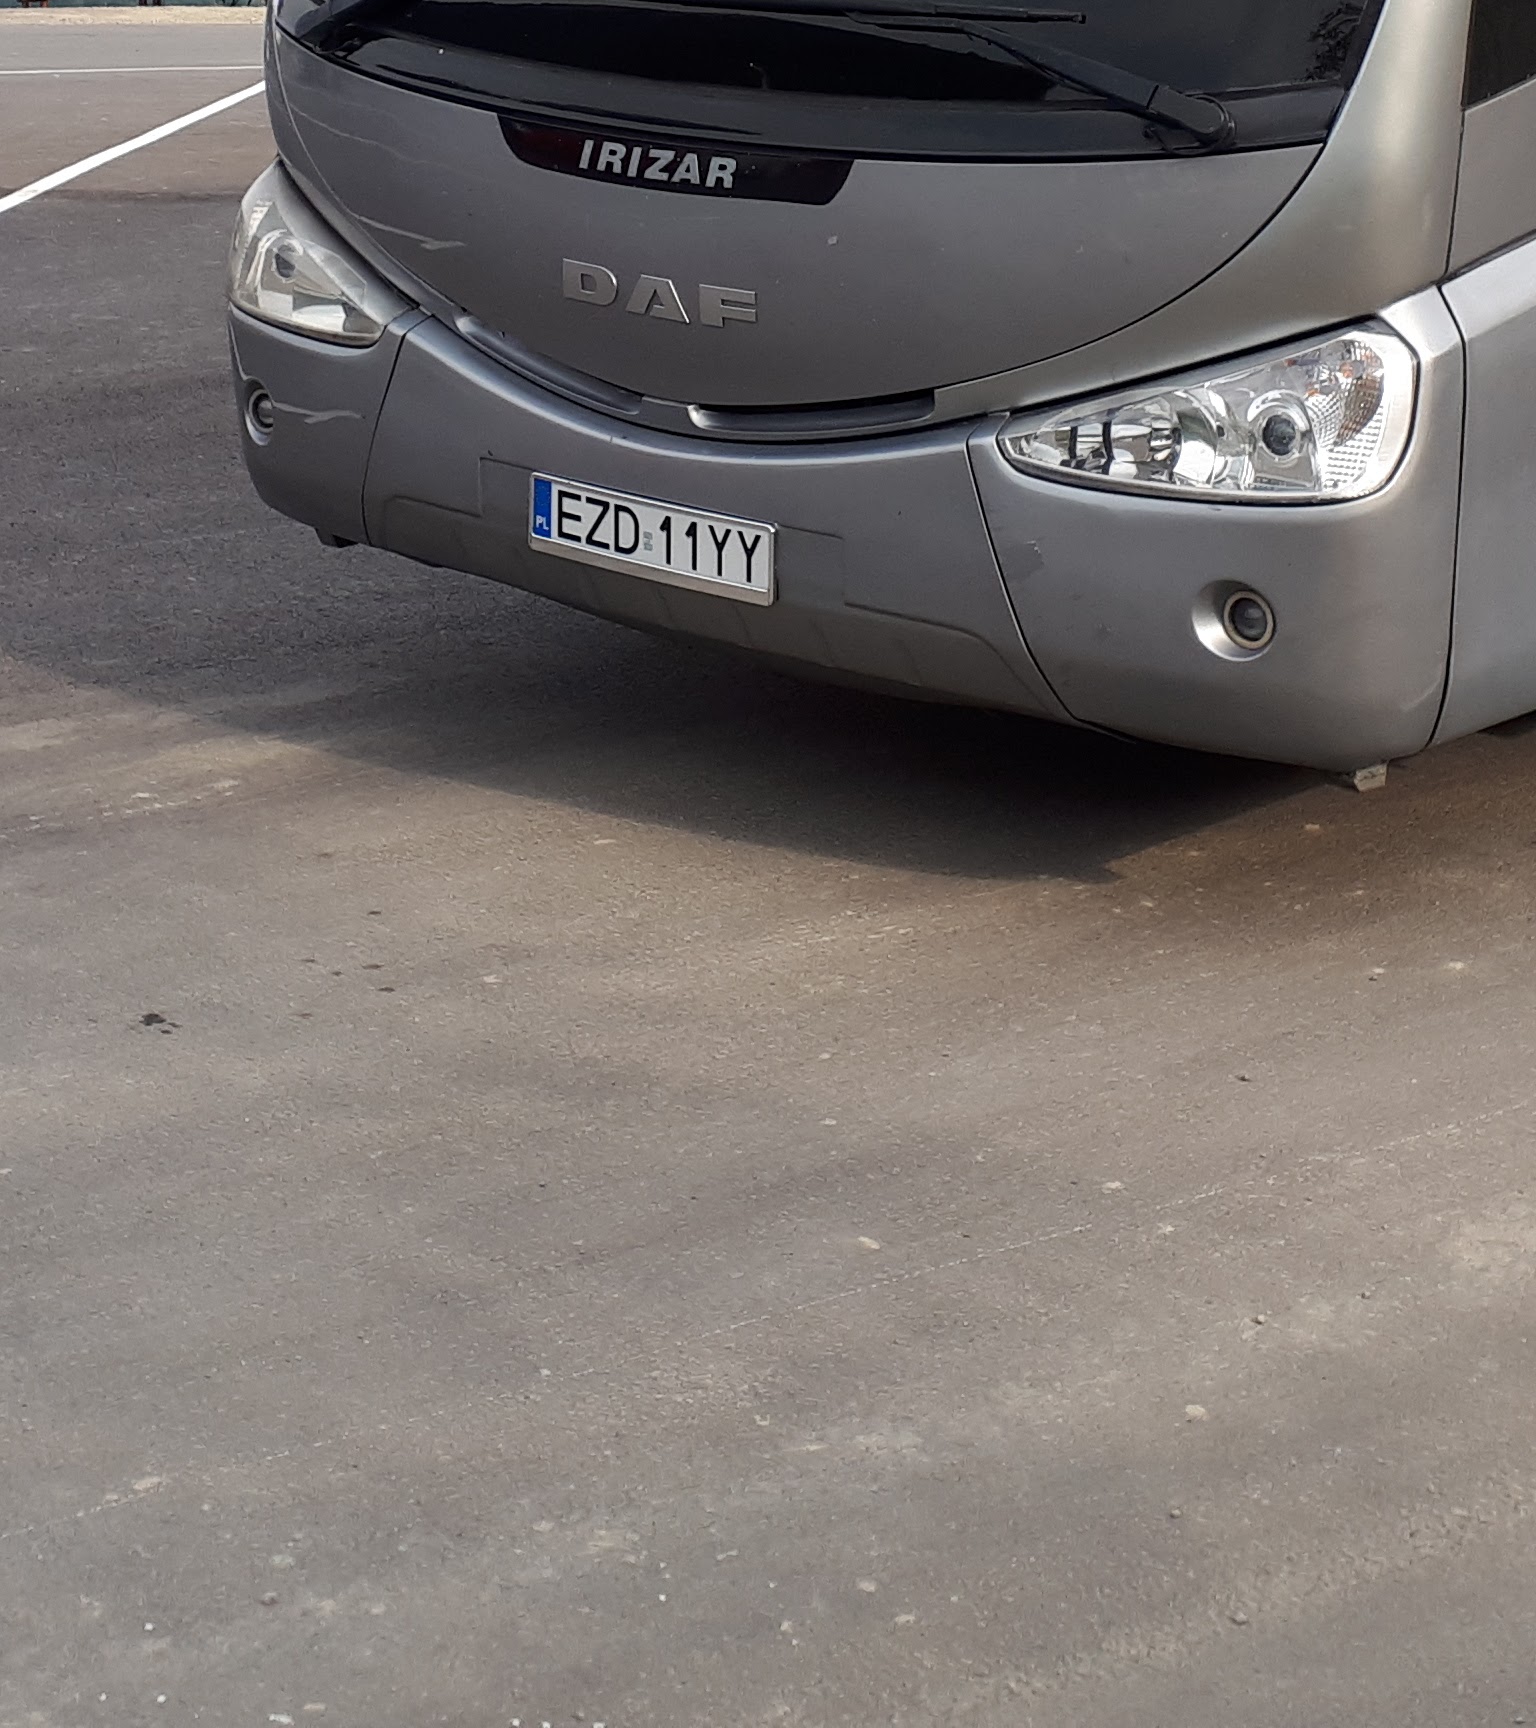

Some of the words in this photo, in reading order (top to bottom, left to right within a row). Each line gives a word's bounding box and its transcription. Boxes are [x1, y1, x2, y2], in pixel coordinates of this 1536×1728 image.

[578, 138, 738, 190] IRIZAR
[562, 257, 758, 328] DAF
[535, 514, 550, 532] PL
[557, 488, 640, 556] EZD
[659, 514, 762, 584] 11YY
